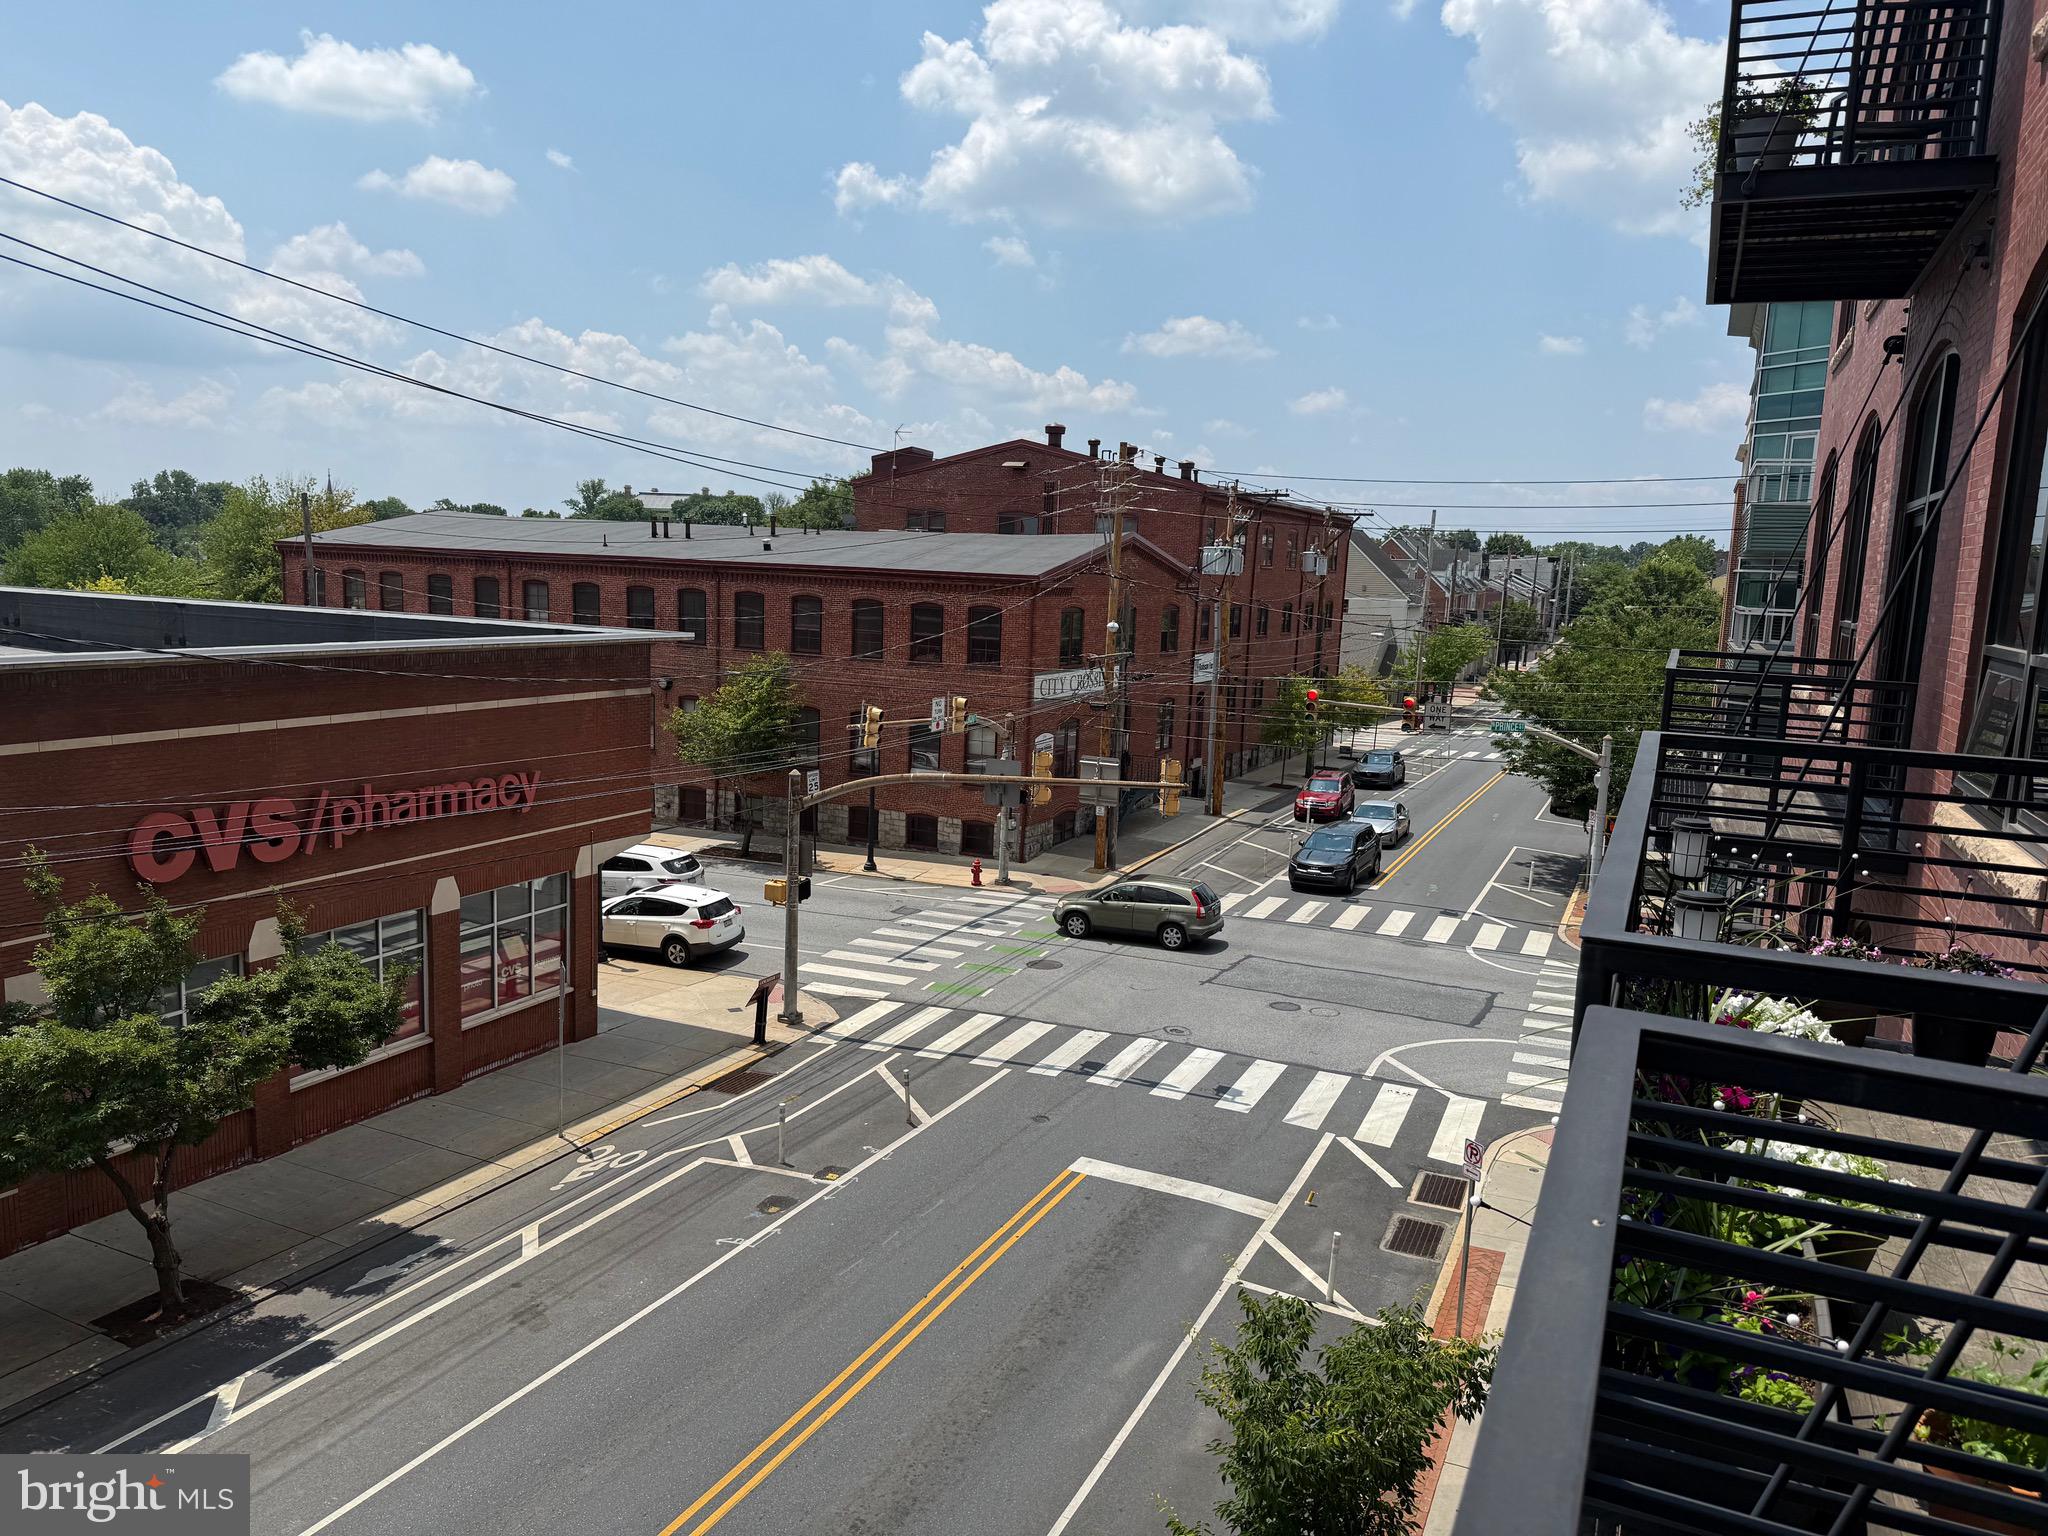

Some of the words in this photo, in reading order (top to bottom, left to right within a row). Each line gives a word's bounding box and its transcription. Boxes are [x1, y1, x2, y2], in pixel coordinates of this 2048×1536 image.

[1040, 676, 1066, 696] CITY
[1496, 721, 1518, 731] PRINCE
[809, 782, 818, 791] 25
[501, 963, 522, 977] CVS
